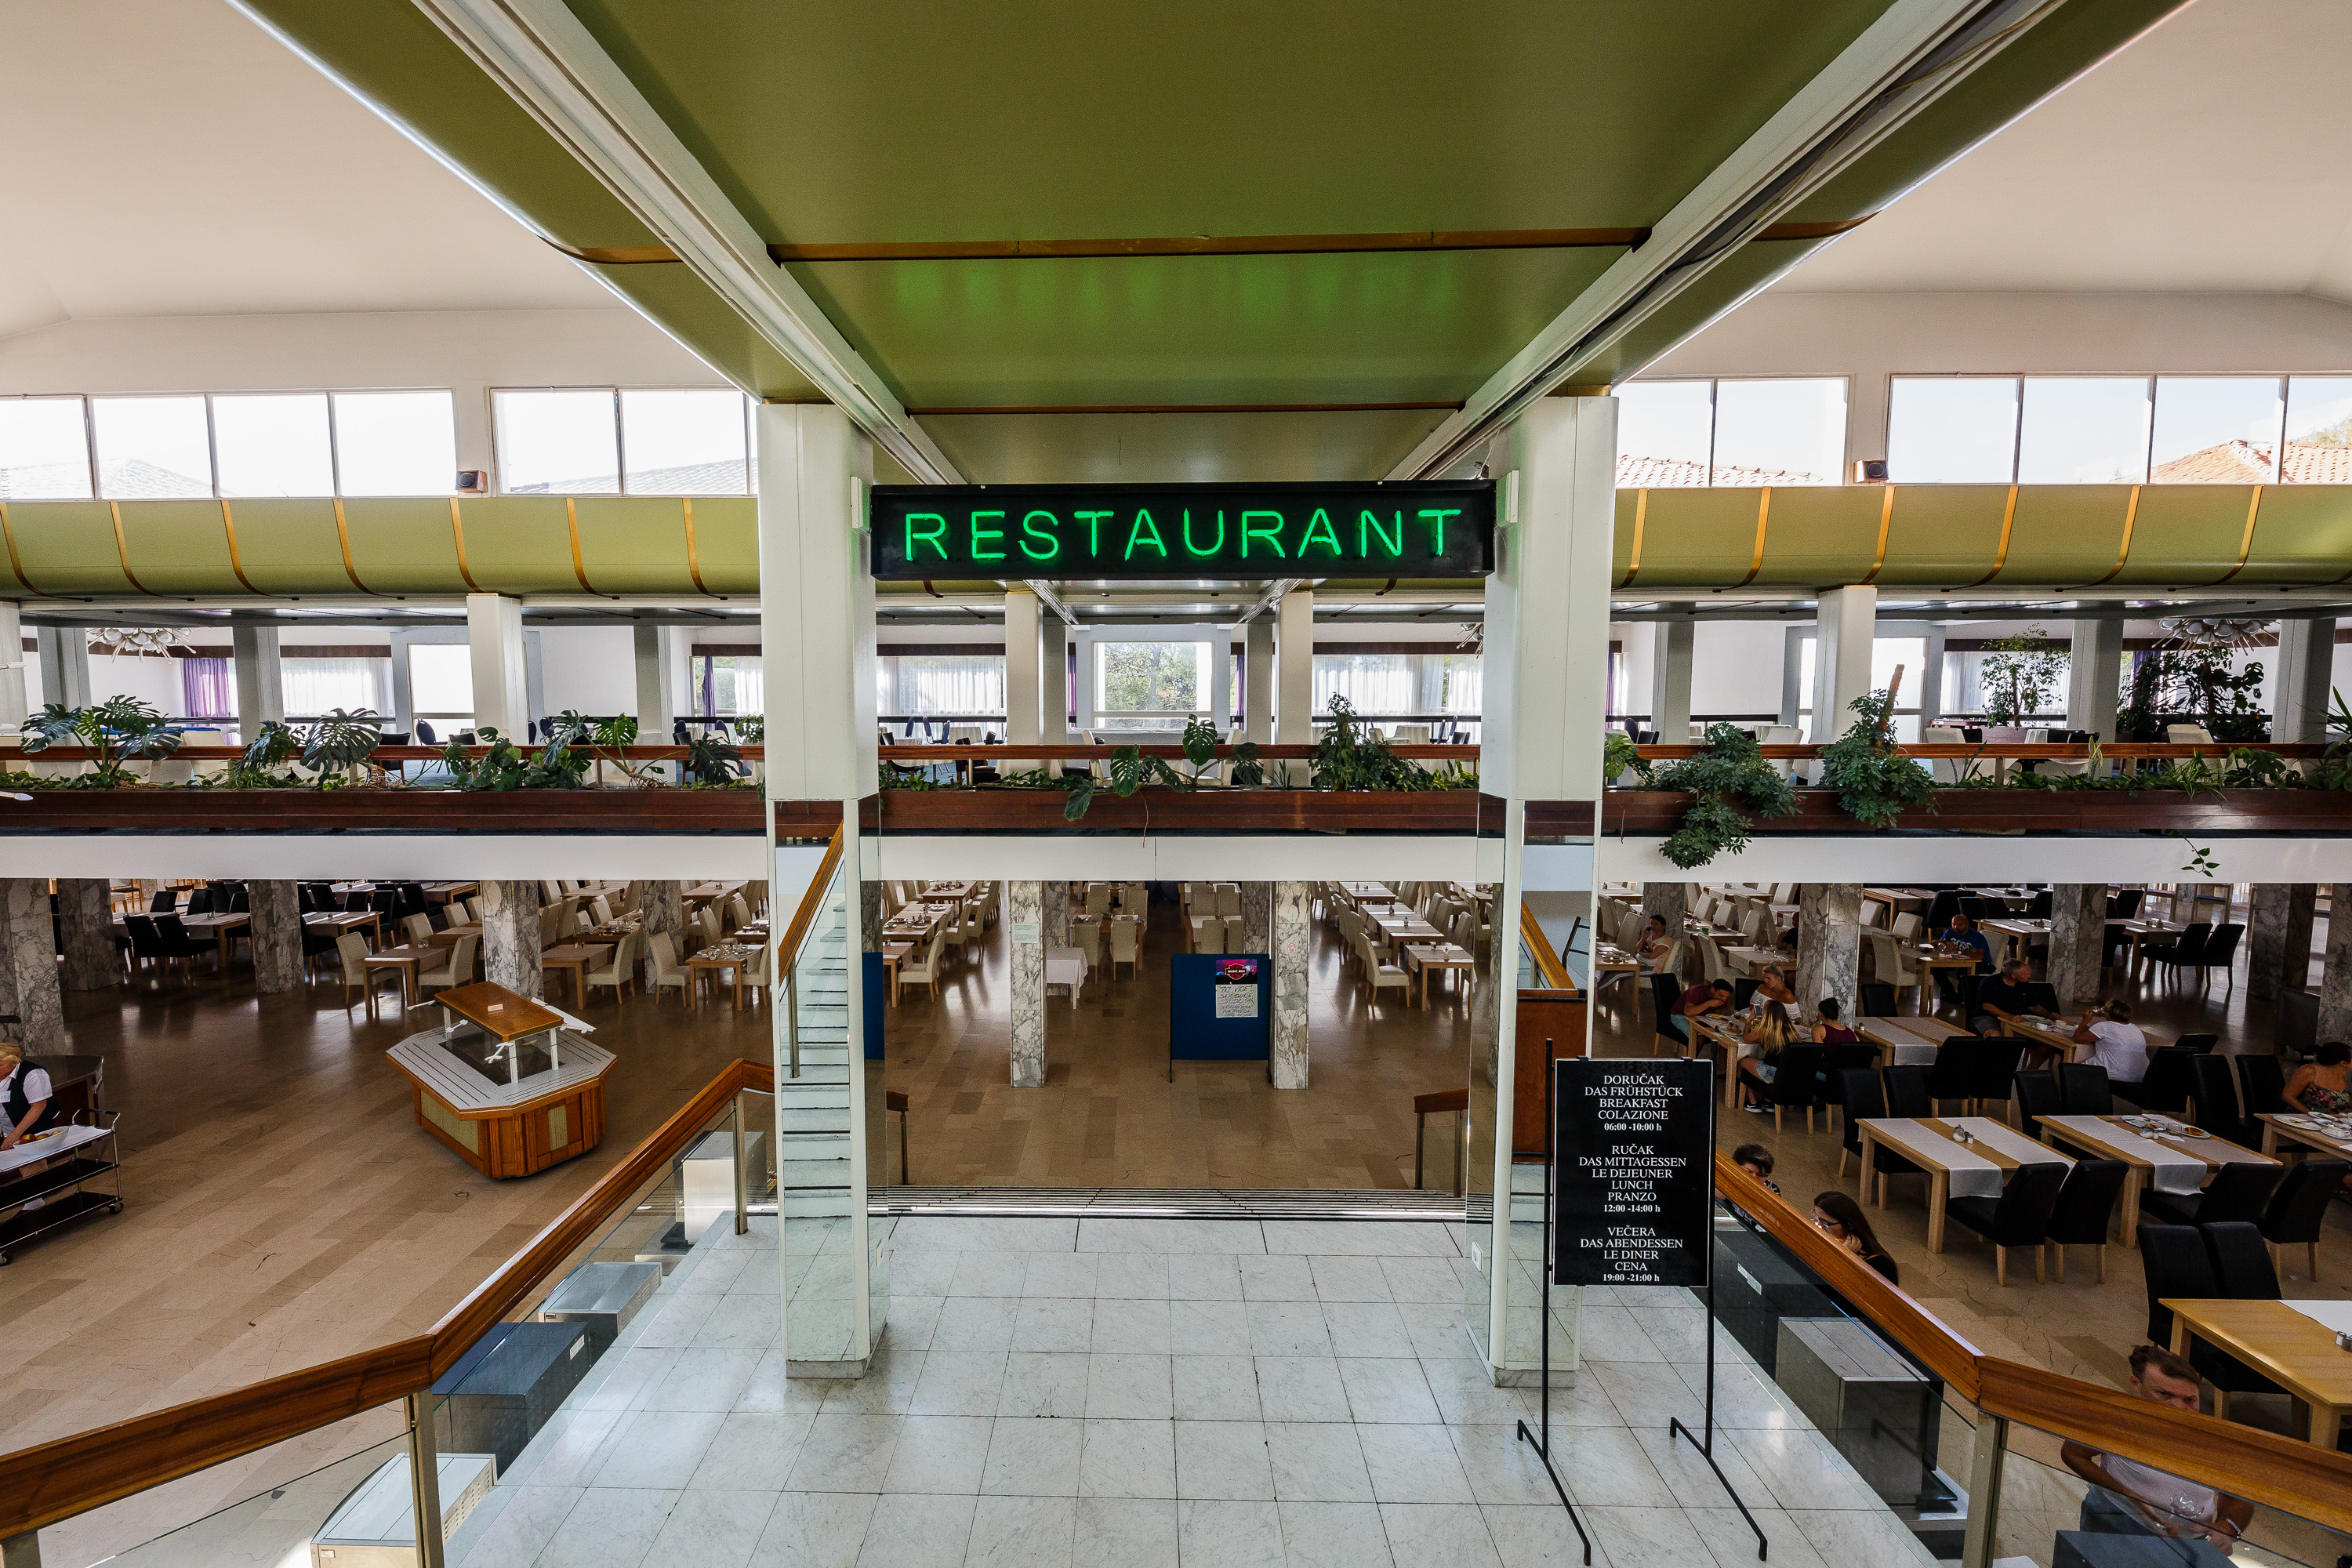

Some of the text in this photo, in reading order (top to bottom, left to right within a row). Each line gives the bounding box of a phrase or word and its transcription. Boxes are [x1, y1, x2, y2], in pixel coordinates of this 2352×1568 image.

[905, 508, 1462, 562] RESTAURANT
[1603, 1073, 1664, 1085] DORUČAK
[1584, 1084, 1683, 1097] DAS FRÜHSTÜCK
[1599, 1098, 1668, 1109] BREAKFAST
[1598, 1109, 1669, 1120] COLAZIONE
[1604, 1123, 1626, 1131] 06:00
[1656, 1123, 1662, 1131] h
[1612, 1143, 1654, 1155] RUČAK
[1579, 1156, 1686, 1167] DAS MITTAGESSEN
[1592, 1168, 1673, 1178] LE DEJEUNER
[1611, 1180, 1653, 1190] LUNCH
[1607, 1192, 1657, 1202] PRANZO
[1604, 1204, 1626, 1213] 12:00
[1655, 1204, 1661, 1213] h
[1607, 1225, 1656, 1236] VEČERA
[1580, 1238, 1683, 1248] DAS ABENDESSEN
[1603, 1250, 1659, 1260] LE DINER
[1614, 1261, 1648, 1272] CENA
[1602, 1273, 1625, 1282] 19:00
[1654, 1273, 1660, 1282] h
